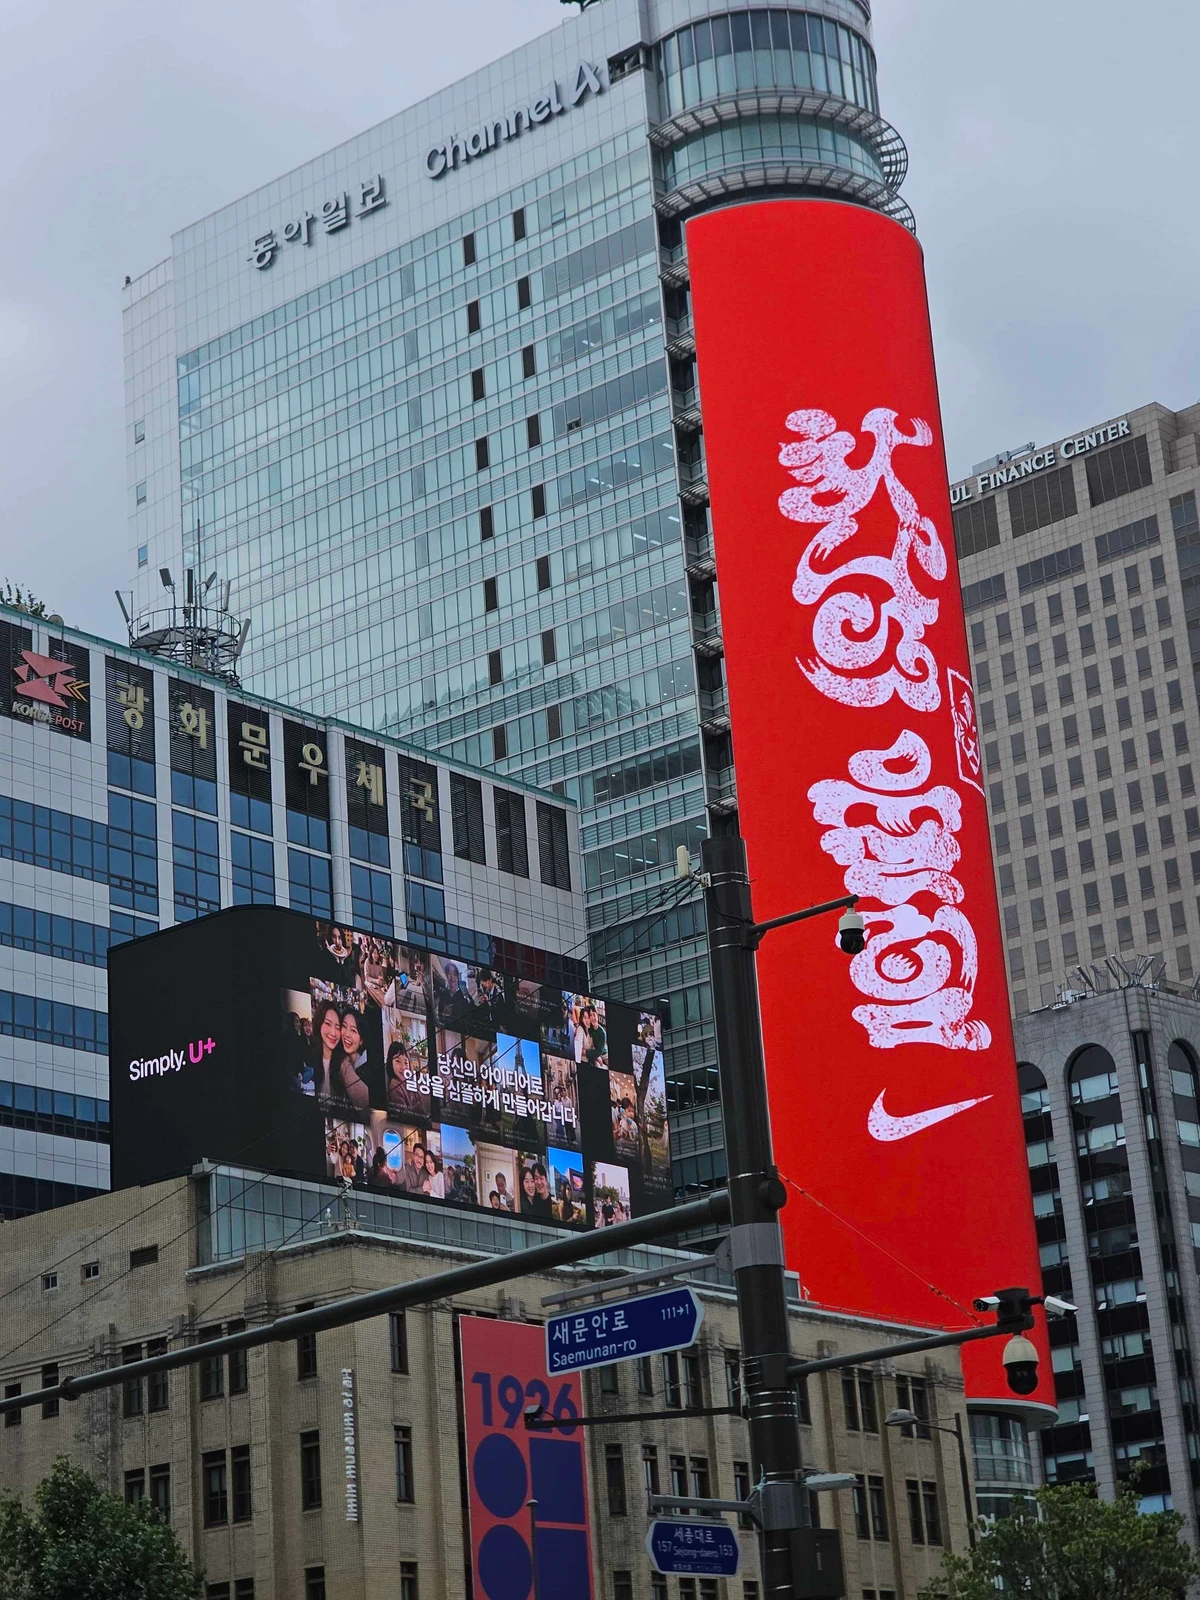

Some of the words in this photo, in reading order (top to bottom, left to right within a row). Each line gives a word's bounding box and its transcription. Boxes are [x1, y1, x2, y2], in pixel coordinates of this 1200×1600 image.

[426, 80, 562, 178] Channel
[570, 58, 602, 105] A
[247, 174, 388, 270] 동아일보
[976, 449, 1056, 494] FINANCE
[1059, 419, 1131, 459] CENTER
[11, 701, 53, 724] KOREA
[54, 715, 86, 733] POST
[115, 679, 435, 823] 광화문우체국
[129, 1048, 186, 1081] Simply.
[189, 1037, 216, 1064] U+
[437, 1052, 478, 1082] 당신의
[479, 1064, 545, 1097] 아이디어로
[403, 1068, 446, 1098] 일상을
[447, 1080, 500, 1112] 심플하게
[502, 1091, 578, 1130] 만들어갑니다
[552, 1309, 629, 1345] 새문안로
[553, 1338, 637, 1368] Saemunan-ro
[471, 1371, 578, 1436] 1926
[657, 1540, 672, 1553] 157
[673, 1545, 719, 1559] Sejong-daero
[718, 1544, 734, 1557] 153
[673, 1526, 716, 1544] 세종대로
